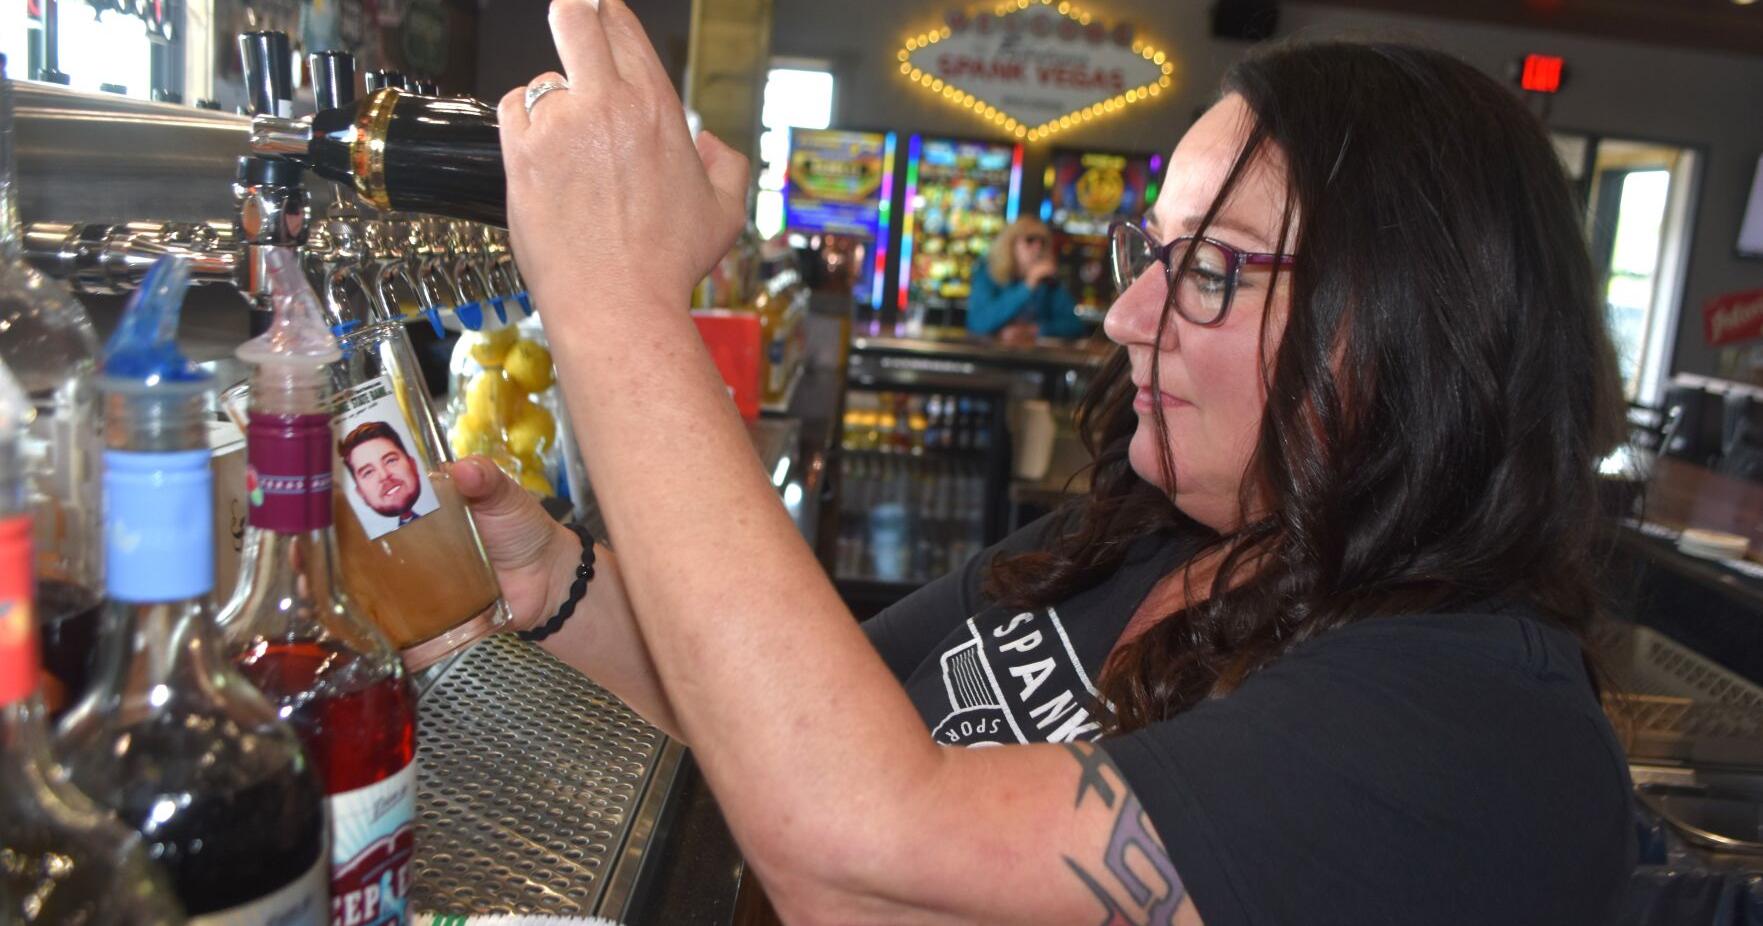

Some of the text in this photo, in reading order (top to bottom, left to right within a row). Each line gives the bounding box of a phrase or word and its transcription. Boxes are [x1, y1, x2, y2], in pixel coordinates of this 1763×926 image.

[937, 53, 1125, 92] SPANK VEGAS
[993, 612, 1104, 743] SPANK
[938, 719, 1001, 746] SPOR
